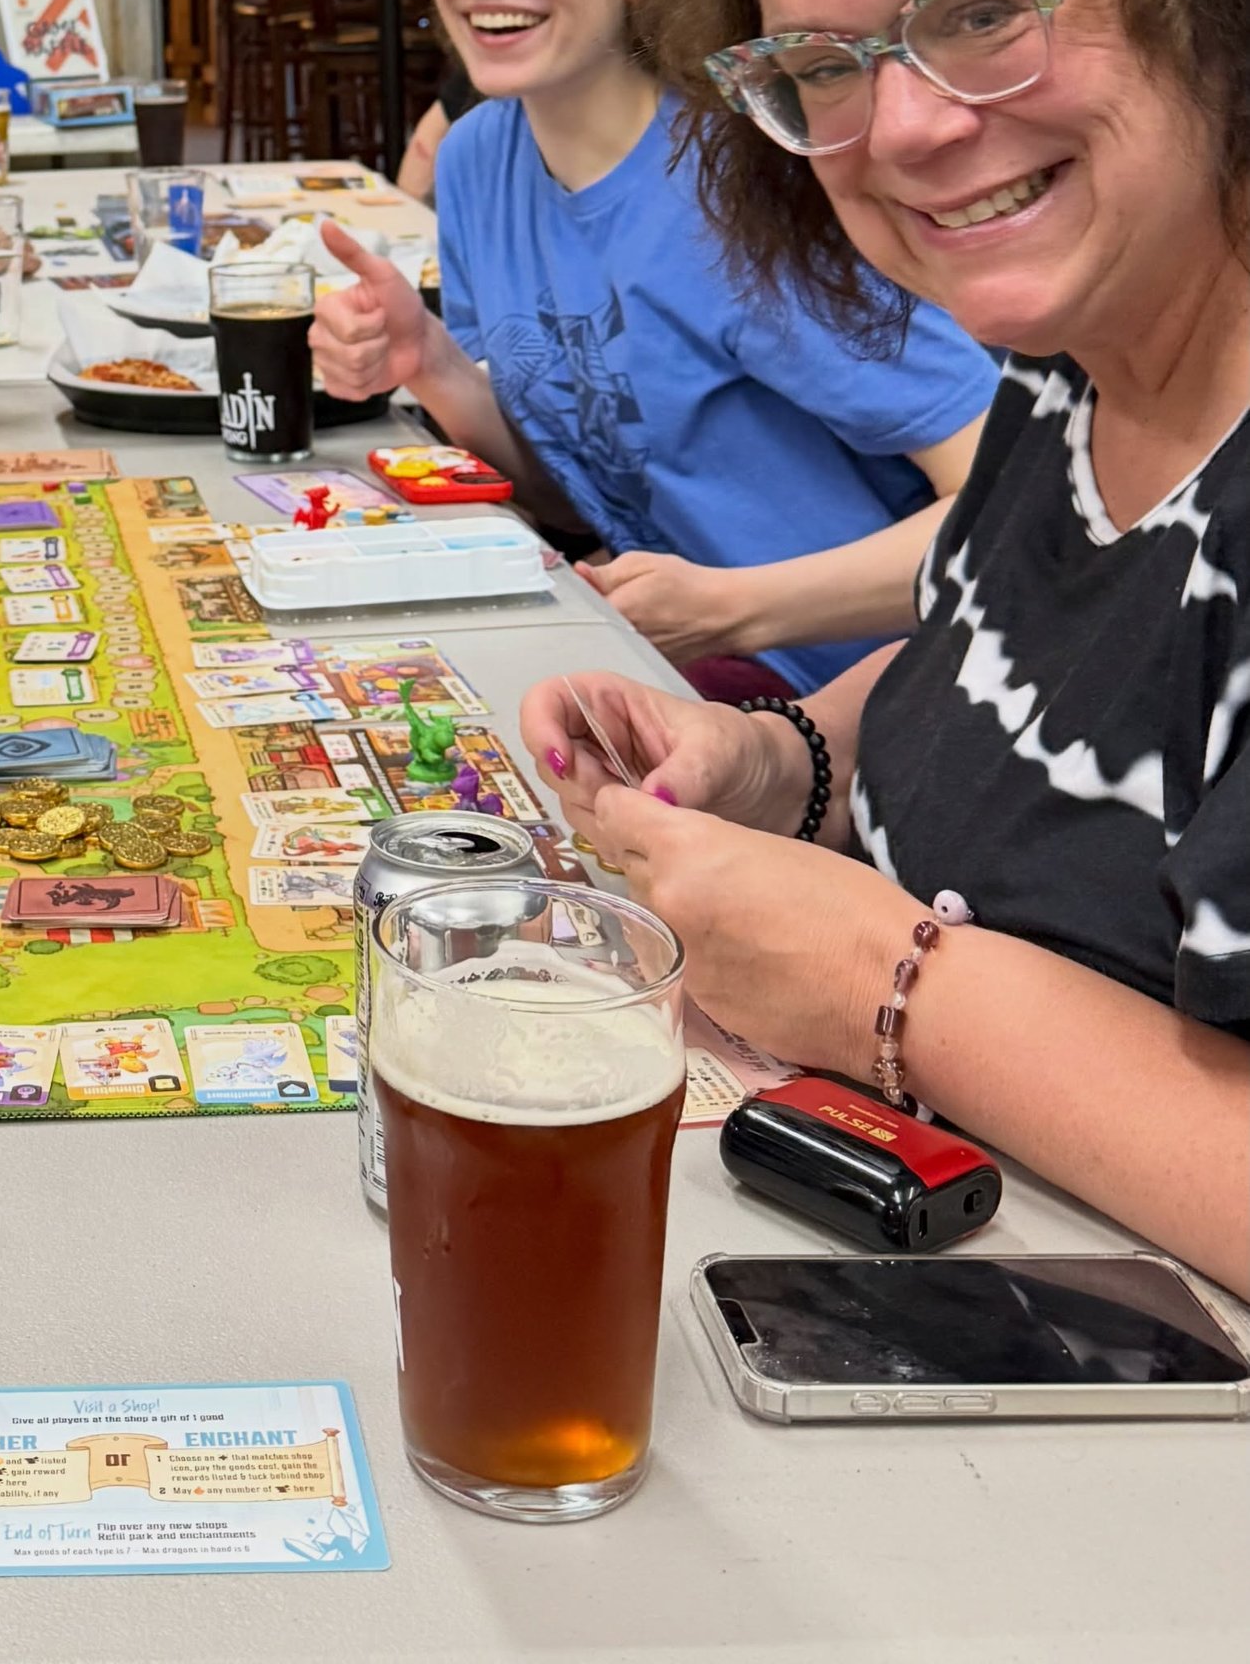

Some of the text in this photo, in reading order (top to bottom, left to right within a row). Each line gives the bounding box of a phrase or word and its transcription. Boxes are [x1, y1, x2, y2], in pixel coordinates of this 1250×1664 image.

[818, 1105, 874, 1132] PULSE
[73, 1398, 161, 1415] Visit a Shop!
[12, 1417, 34, 1425] Give
[37, 1416, 49, 1425] all
[52, 1416, 89, 1426] players
[92, 1416, 102, 1424] at
[105, 1415, 122, 1423] the
[124, 1415, 149, 1423] shop
[160, 1414, 177, 1423] gift
[179, 1414, 190, 1422] of
[200, 1413, 224, 1423] good
[184, 1430, 298, 1447] ENCHANT
[5, 1457, 22, 1465] and
[41, 1456, 67, 1465] listed
[105, 1453, 131, 1467] or
[156, 1455, 162, 1463] 1
[169, 1454, 202, 1463] Choose
[231, 1453, 250, 1461] that
[251, 1453, 289, 1462] matches
[291, 1453, 313, 1462] shop
[11, 1468, 30, 1477] gain
[33, 1467, 66, 1476] reward
[170, 1464, 193, 1473] icon,
[194, 1463, 211, 1473] pay
[212, 1463, 227, 1471] the
[228, 1462, 257, 1472] goods
[281, 1461, 301, 1471] gain
[303, 1461, 318, 1470] the
[171, 1473, 210, 1482] rewards
[211, 1472, 238, 1481] listed
[248, 1472, 268, 1481] tuck
[269, 1471, 301, 1480] behind
[303, 1471, 325, 1481] shop
[42, 1489, 59, 1499] any
[159, 1484, 316, 1496] 2 May any number of here
[3, 1522, 92, 1541] End of Turn
[96, 1521, 228, 1532] Flip over any new shops
[98, 1530, 257, 1542] Refill park and enchantments
[14, 1548, 32, 1557] Max
[34, 1548, 58, 1557] goods
[62, 1547, 71, 1556] of
[73, 1547, 93, 1555] each
[95, 1547, 114, 1557] type
[116, 1547, 124, 1555] is
[142, 1546, 160, 1554] Max
[162, 1546, 198, 1555] dragons
[210, 1545, 232, 1553] hand
[234, 1545, 243, 1553] is
